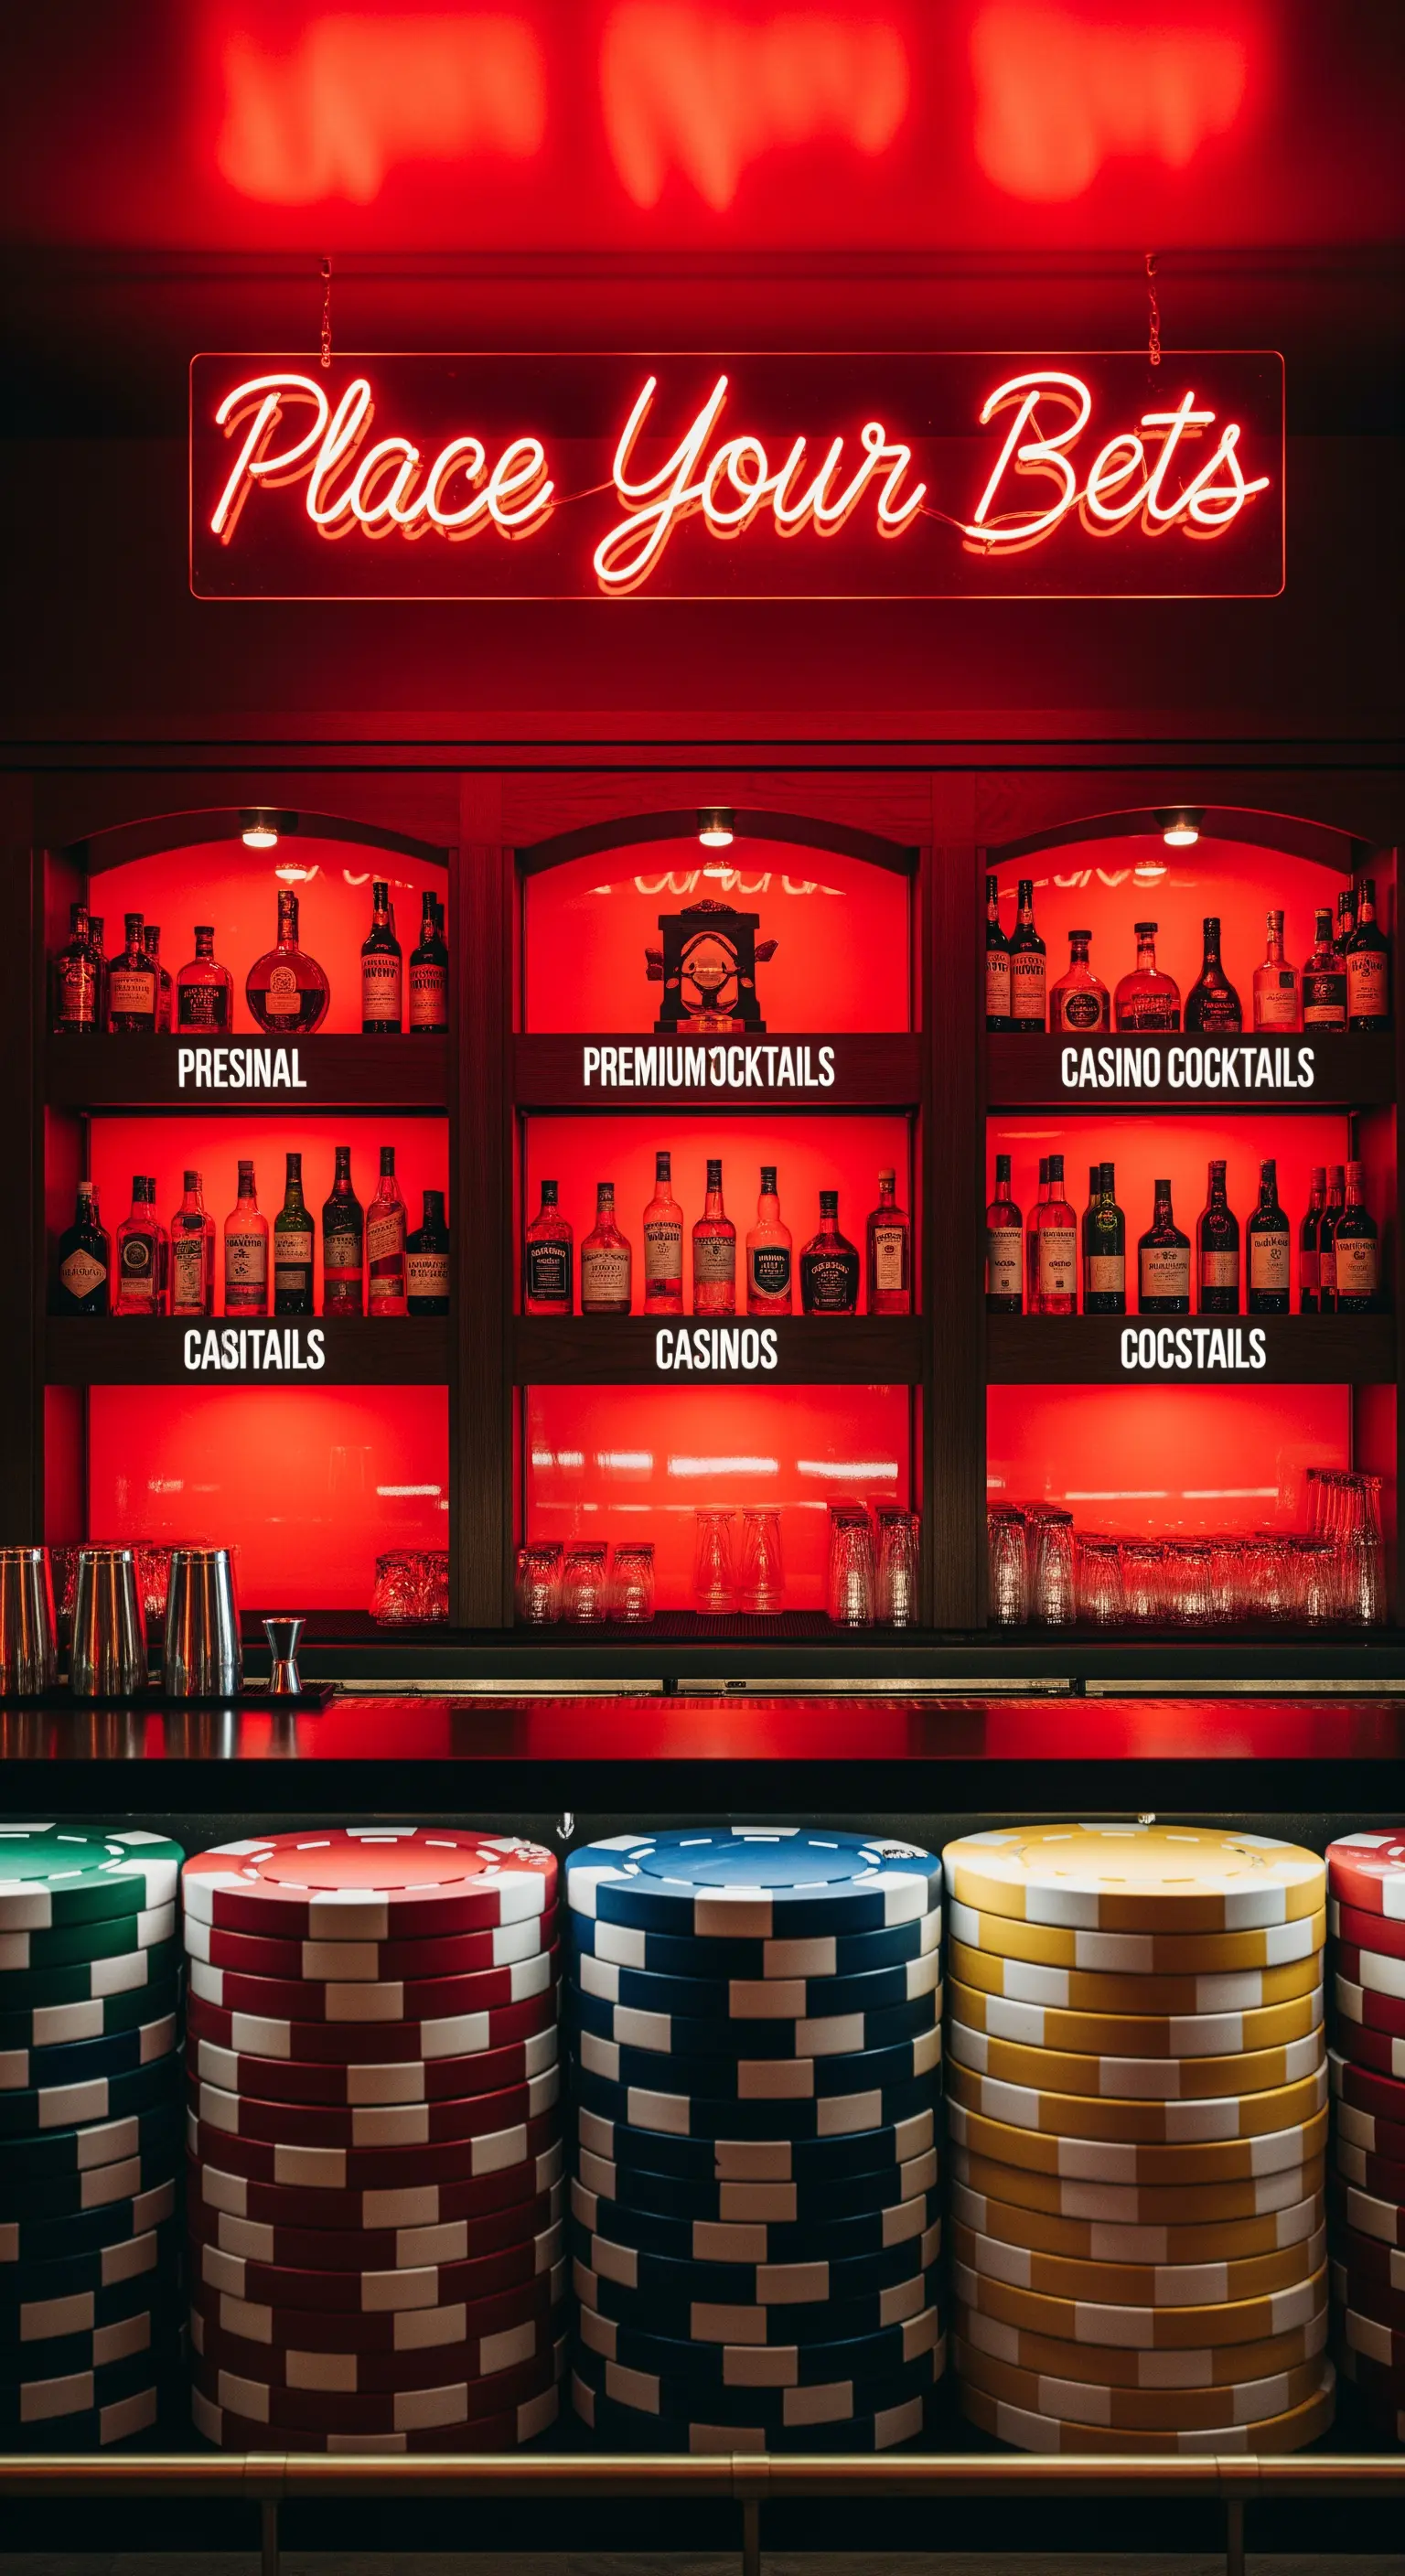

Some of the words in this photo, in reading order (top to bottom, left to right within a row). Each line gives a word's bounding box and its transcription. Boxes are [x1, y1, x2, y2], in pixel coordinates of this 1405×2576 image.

[210, 373, 554, 540] Place
[593, 374, 927, 593] Your
[961, 371, 1271, 549] Bets
[177, 1047, 307, 1088] PRESINAL
[1061, 1046, 1161, 1088] CASINO
[1167, 1046, 1314, 1088] COCKTAILS
[184, 1328, 326, 1370] CASITAILS
[656, 1327, 778, 1370] CASINOS
[1121, 1327, 1267, 1369] COCSTAILS
